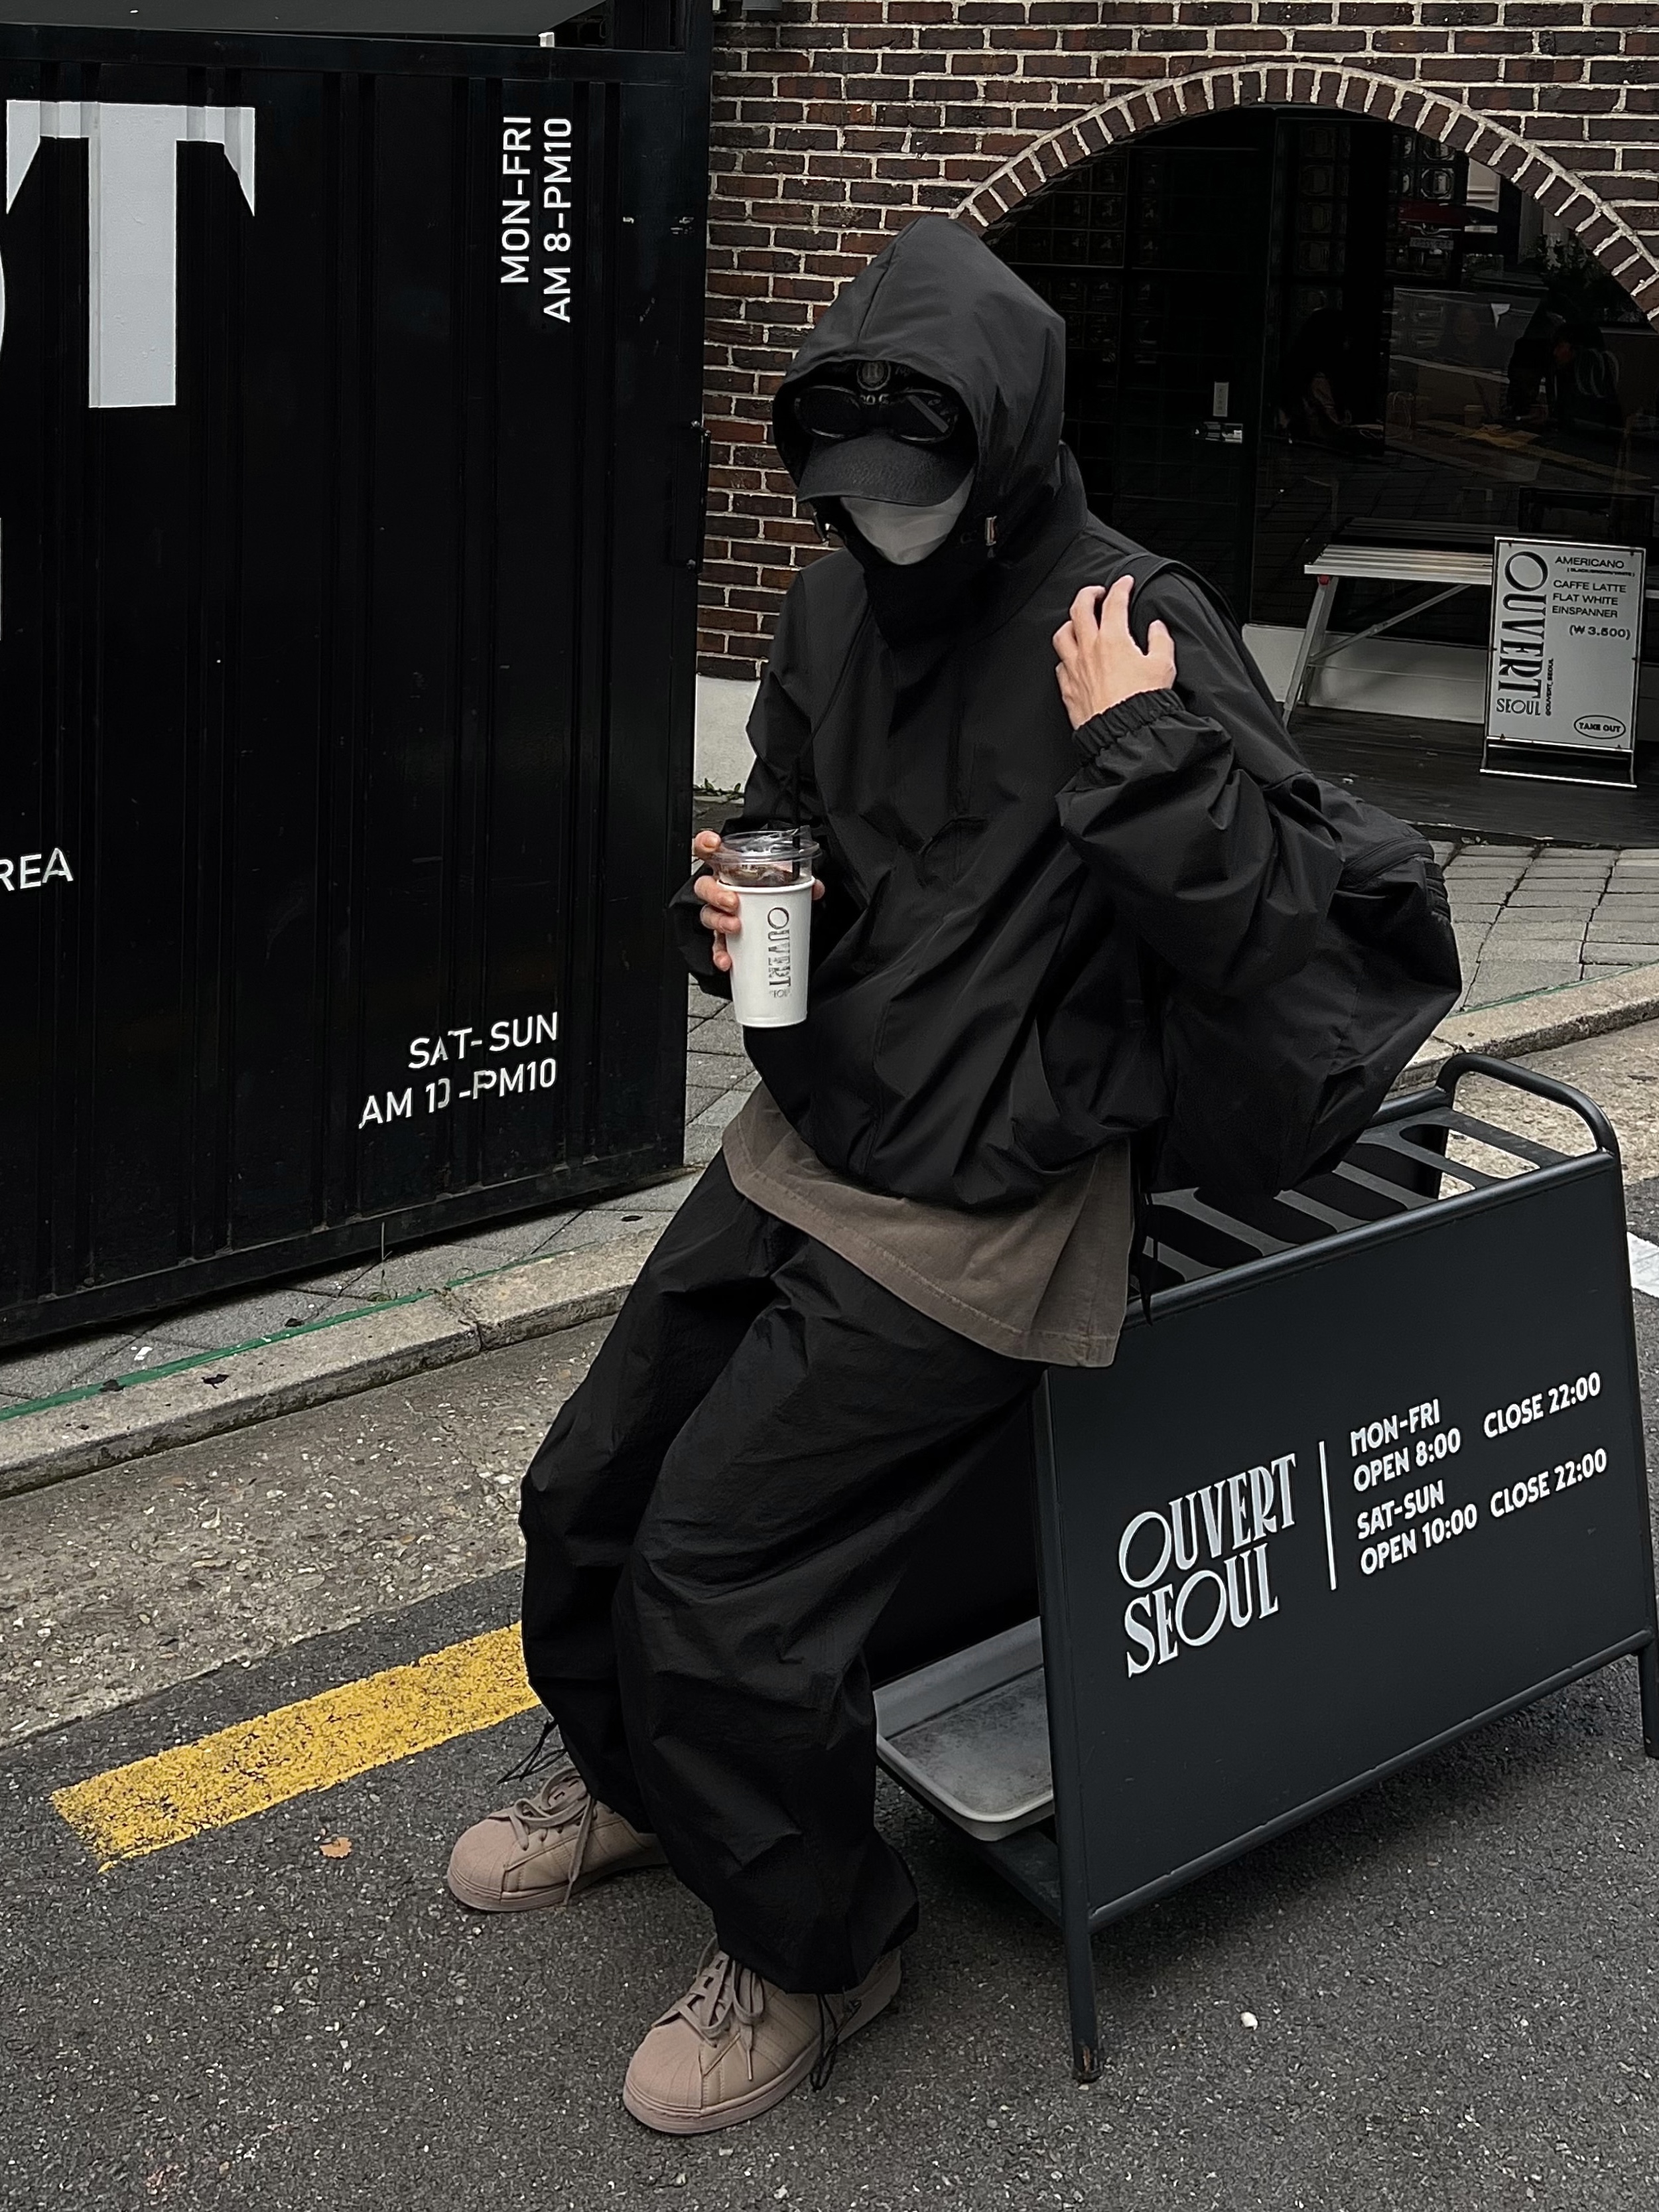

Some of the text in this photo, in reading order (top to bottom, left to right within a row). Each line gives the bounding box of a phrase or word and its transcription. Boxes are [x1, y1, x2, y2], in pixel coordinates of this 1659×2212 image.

[501, 117, 531, 283] MON-FRI
[544, 119, 571, 322] AM 8-PM10
[1554, 580, 1626, 593] CAFFE LATTE
[1555, 557, 1625, 569] AMERICANO
[1498, 552, 1548, 698] OUVERT
[1552, 606, 1617, 618] EINSPANNER
[1553, 593, 1618, 605] FLAT WHITE
[1496, 699, 1540, 715] SEOUL
[767, 907, 791, 987] OUVERT
[409, 1012, 557, 1068] SAT-SUN
[359, 1087, 412, 1129] AM
[1351, 1399, 1439, 1456] MON-FRI
[1354, 1372, 1600, 1491] OPEN 8:00 CLOSE 22:00
[1119, 1454, 1295, 1588] OUVERT
[1358, 1480, 1444, 1539] SAT-SUN
[1361, 1448, 1607, 1574] OPEN 10:00 CLOSE 22:00
[1125, 1543, 1278, 1677] SEOUL
